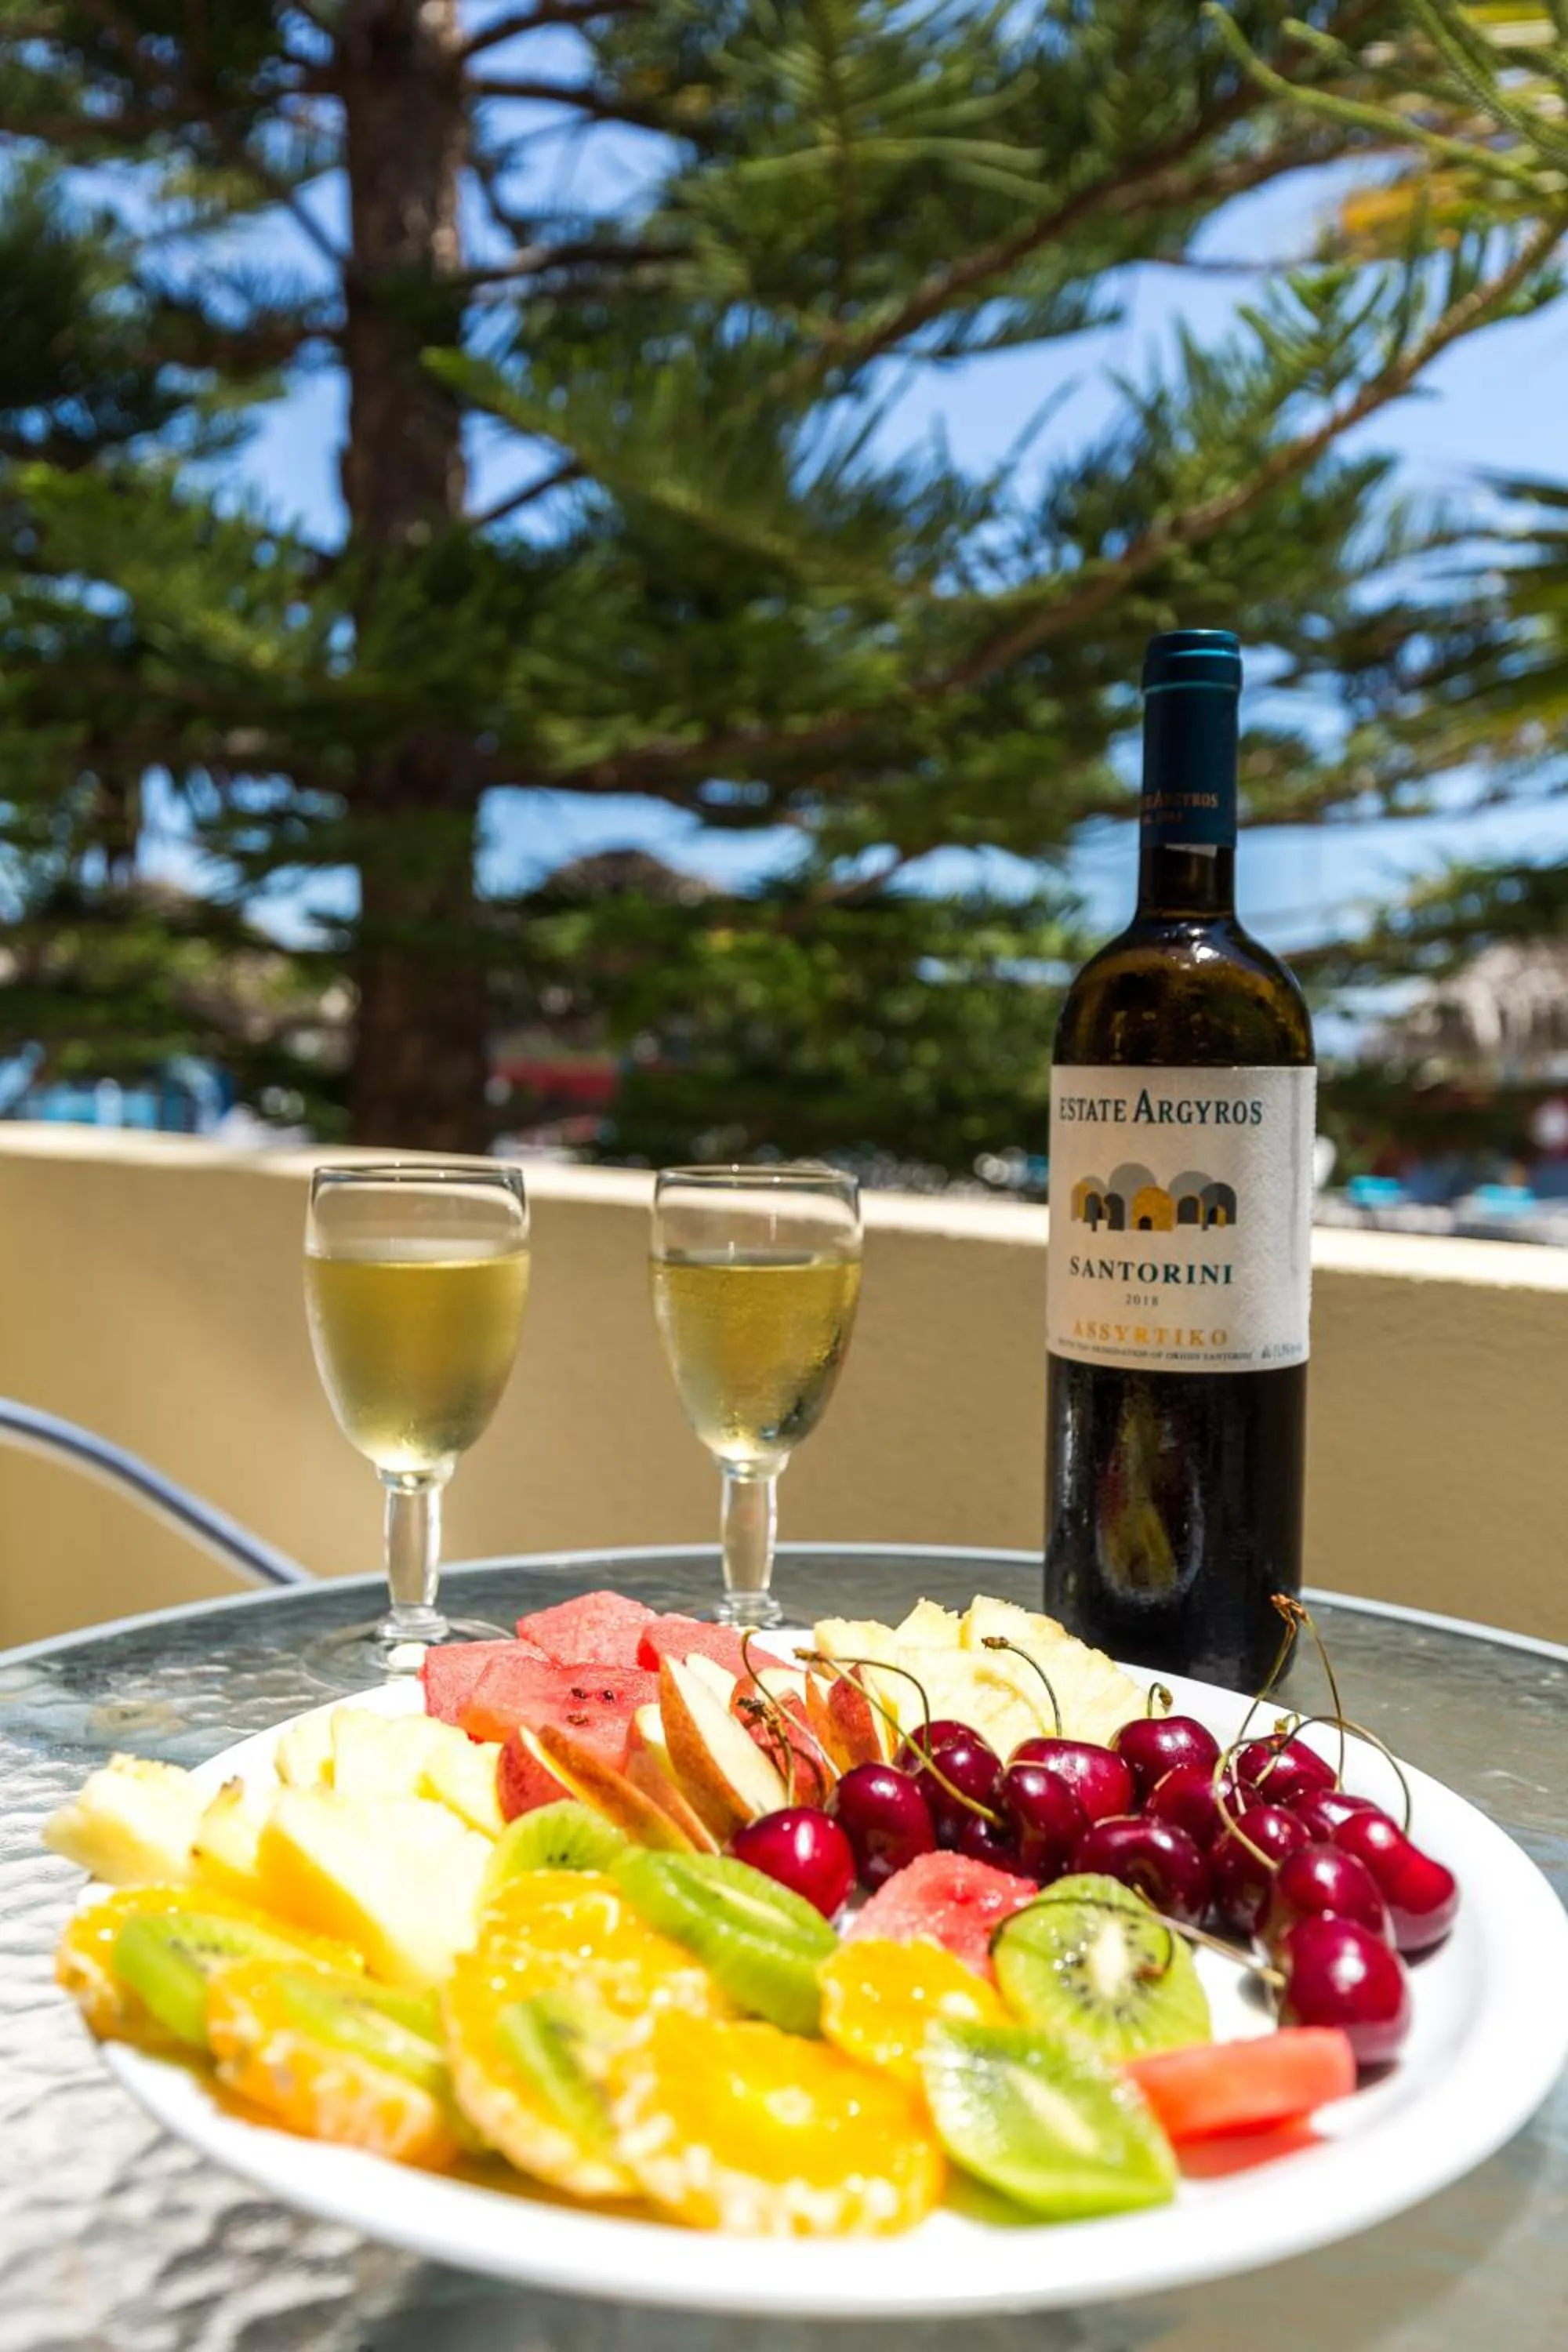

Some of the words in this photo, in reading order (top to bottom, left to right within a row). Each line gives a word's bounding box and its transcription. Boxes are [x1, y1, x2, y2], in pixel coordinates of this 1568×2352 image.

[1059, 1097, 1127, 1123] ESTATE
[1132, 1088, 1263, 1126] ARGYROS
[1069, 1255, 1233, 1285] SANTORINI
[1125, 1294, 1160, 1307] 2018
[1072, 1319, 1229, 1347] ASSYRTIKO
